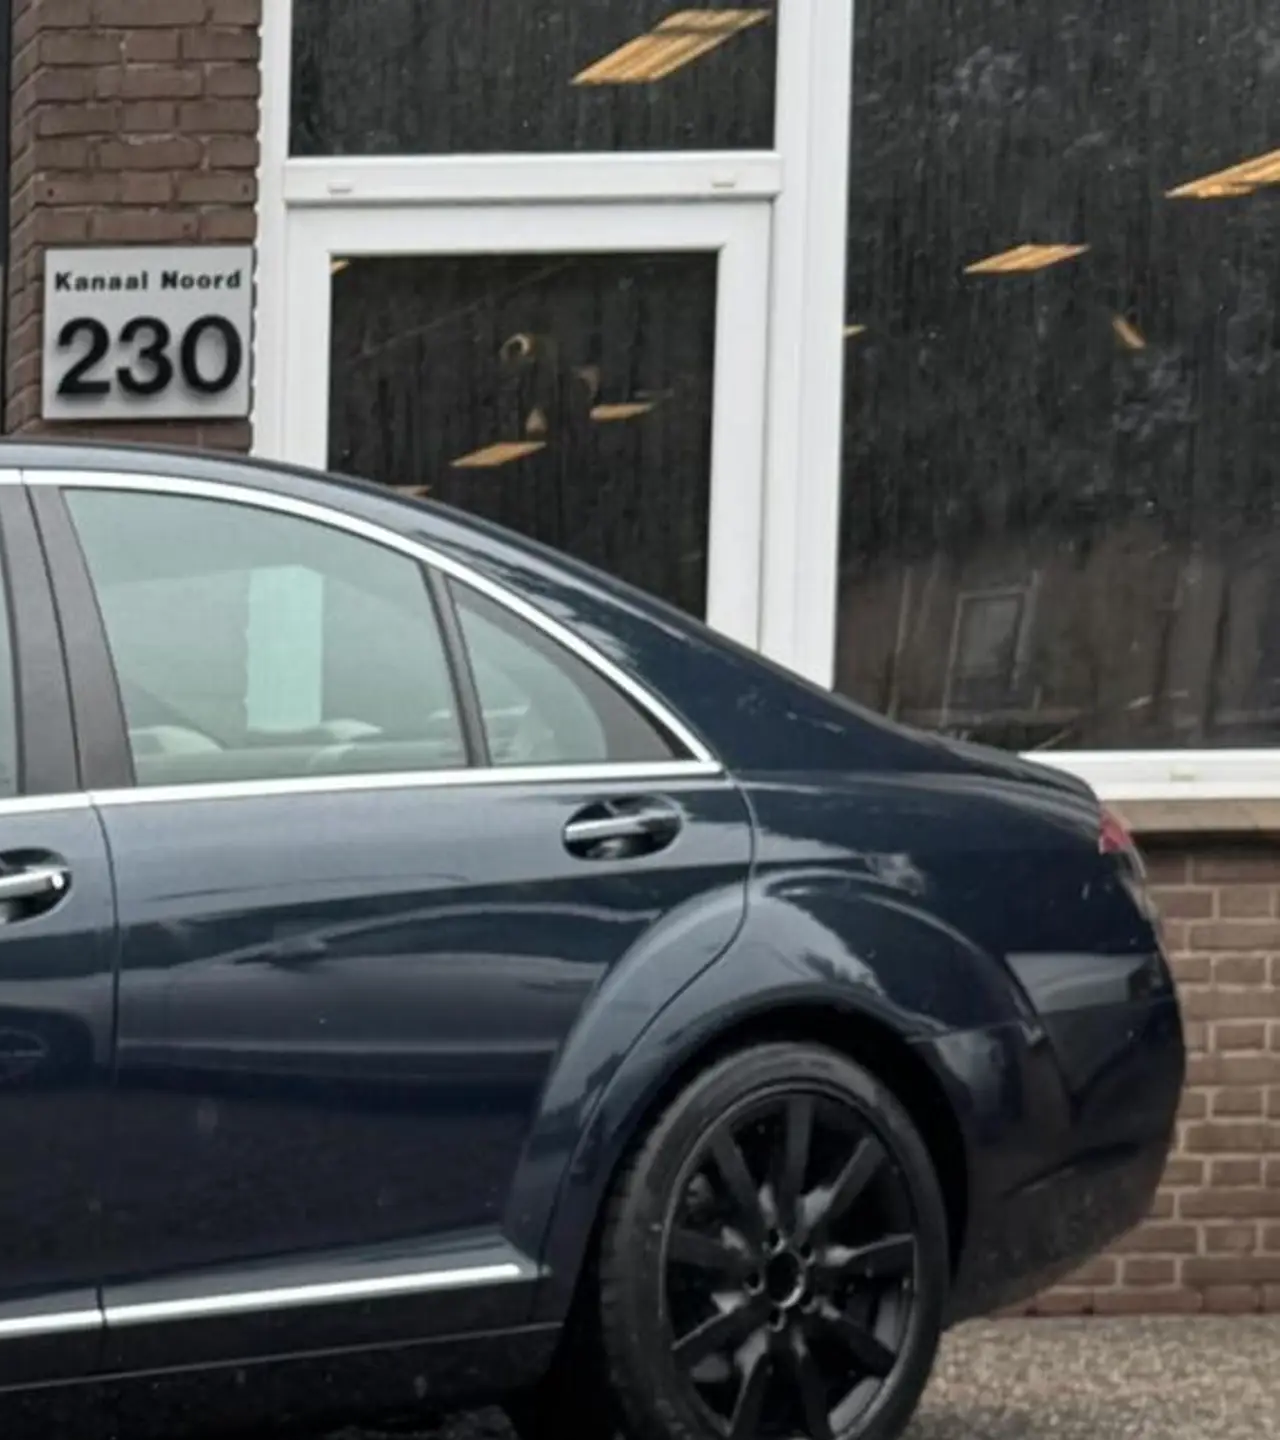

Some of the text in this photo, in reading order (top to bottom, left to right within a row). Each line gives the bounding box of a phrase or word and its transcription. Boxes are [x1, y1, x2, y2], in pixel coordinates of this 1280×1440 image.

[55, 269, 241, 291] Kanaal Noord
[57, 314, 242, 396] 230
